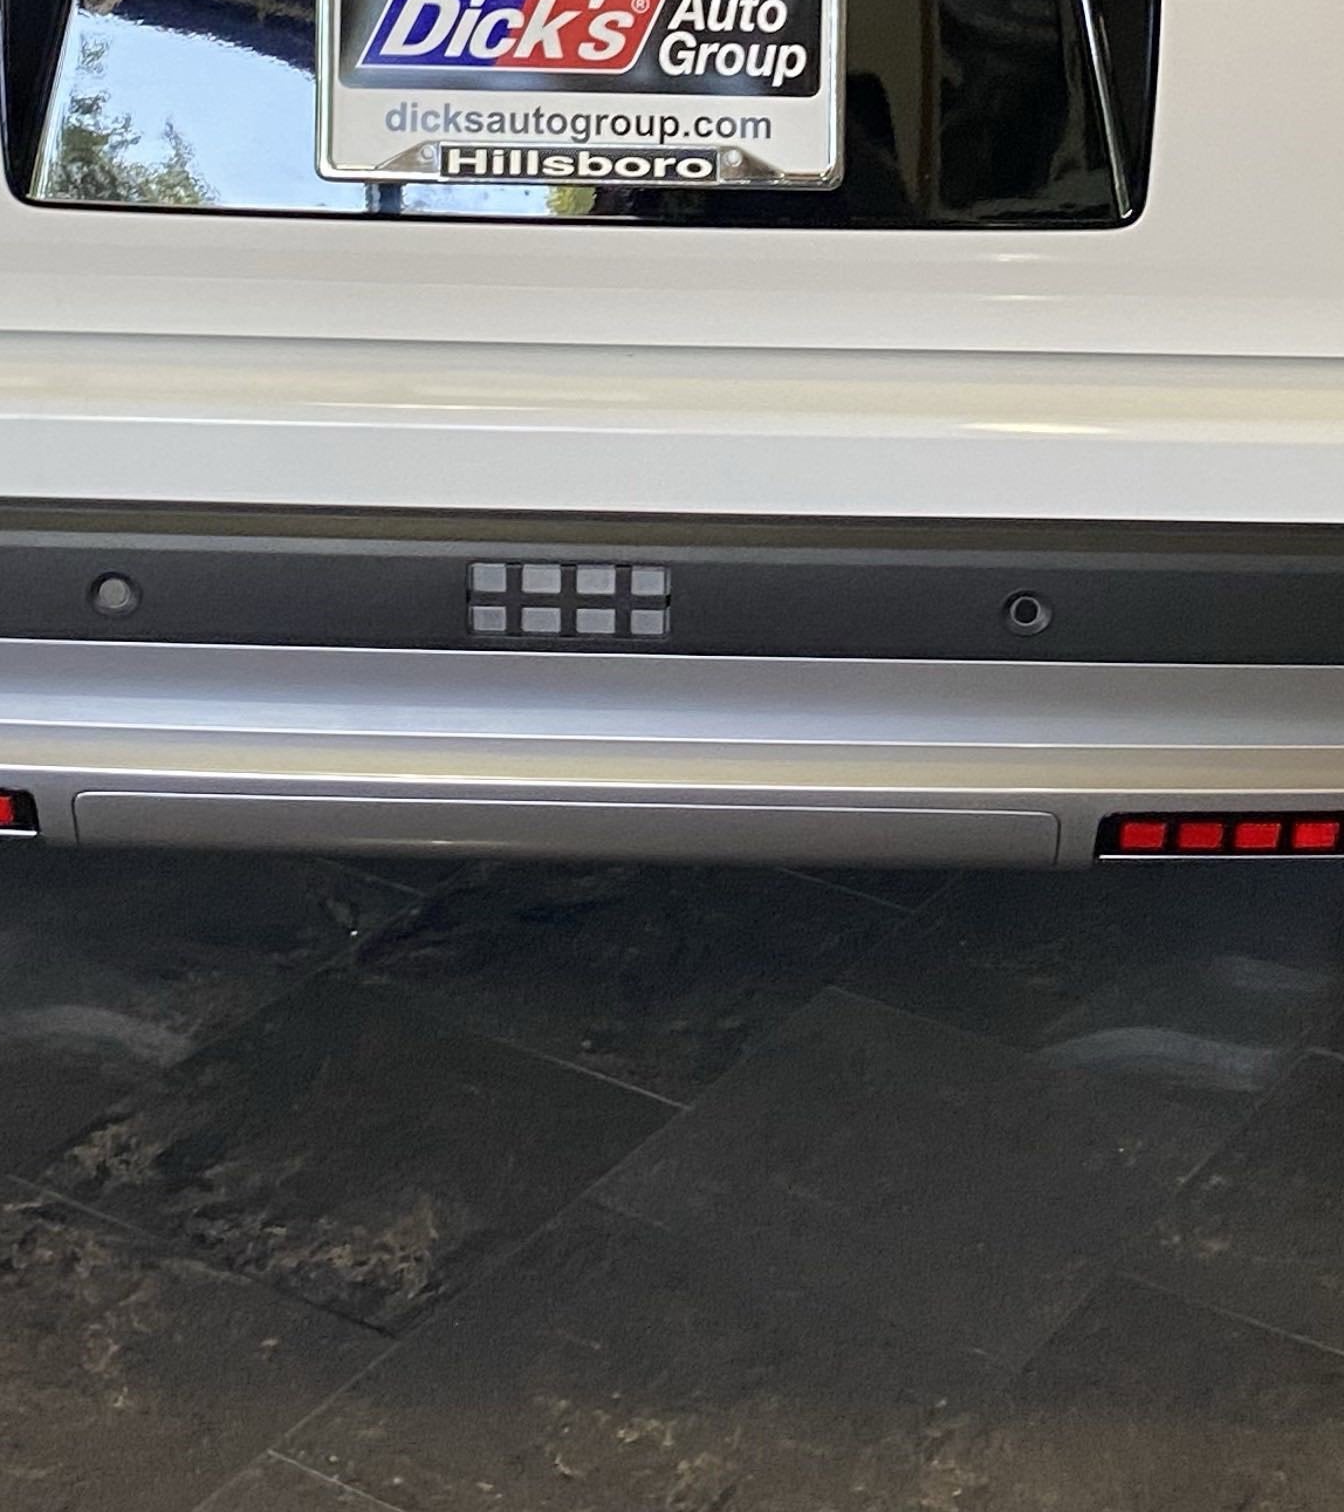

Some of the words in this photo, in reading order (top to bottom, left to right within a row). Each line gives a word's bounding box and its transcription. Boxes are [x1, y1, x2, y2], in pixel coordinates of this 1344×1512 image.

[657, 31, 808, 87] Group
[384, 101, 773, 145] dicksautogroup.com
[445, 147, 714, 180] Hillsboro
